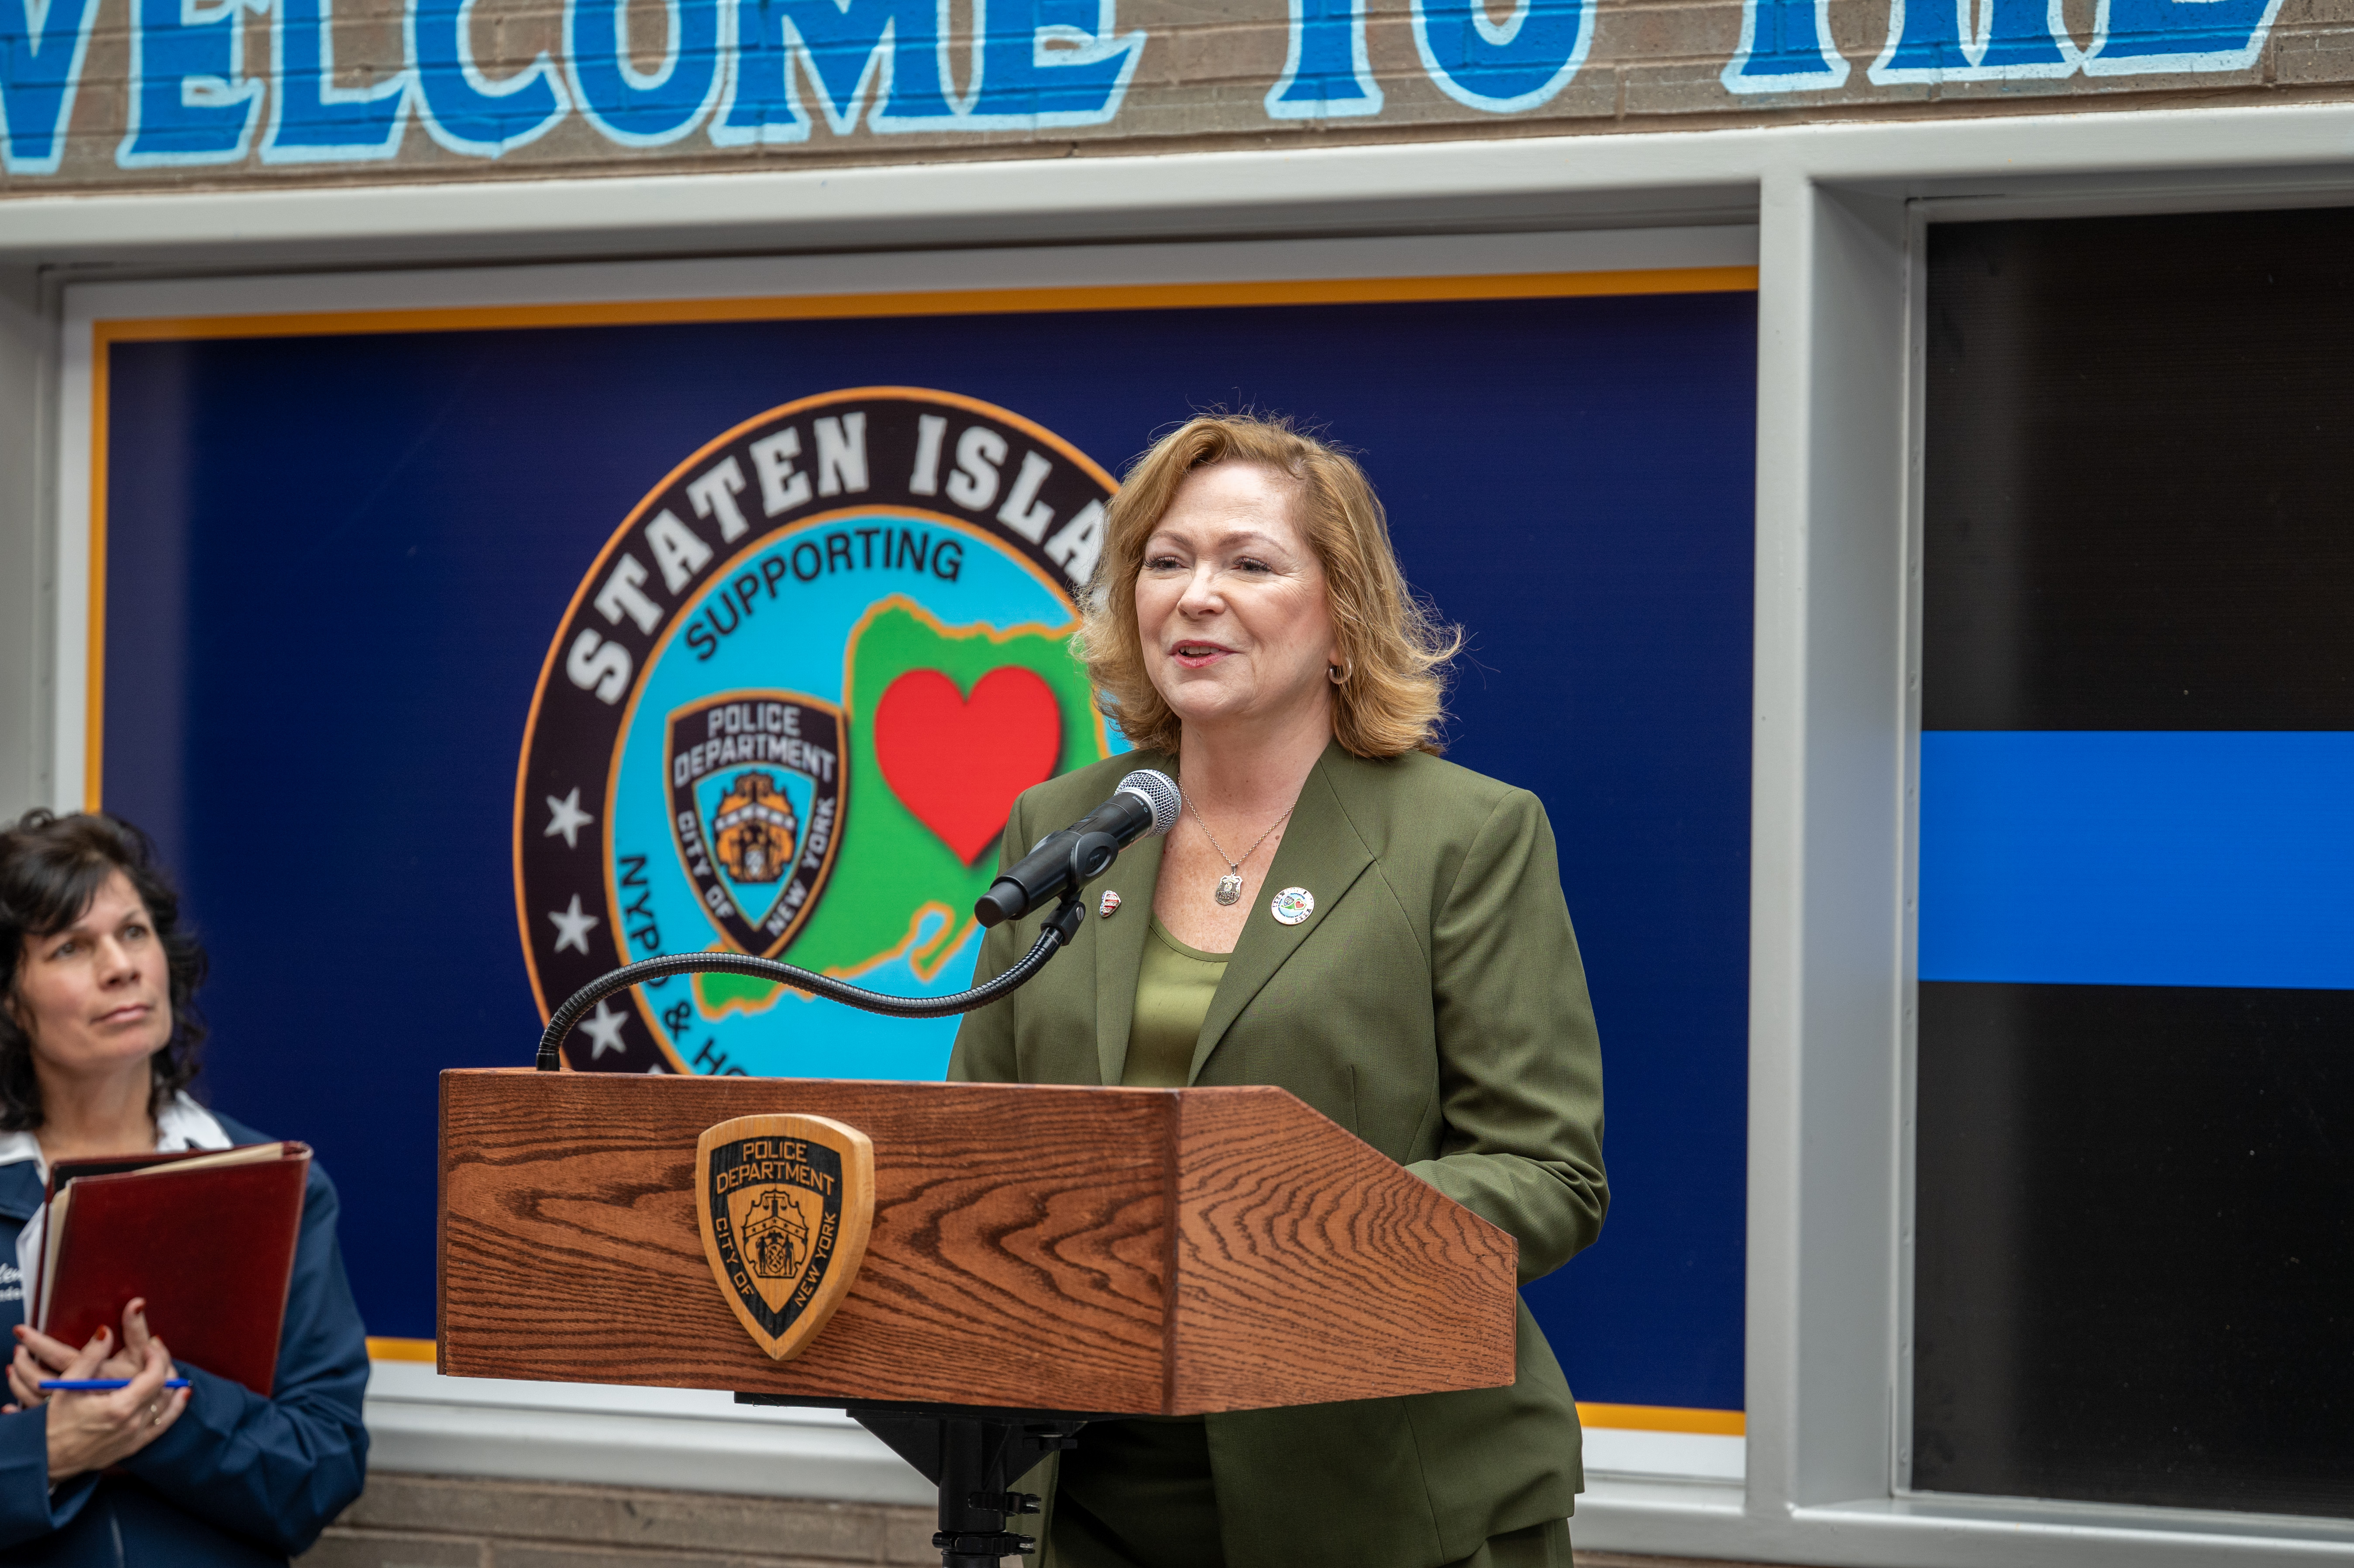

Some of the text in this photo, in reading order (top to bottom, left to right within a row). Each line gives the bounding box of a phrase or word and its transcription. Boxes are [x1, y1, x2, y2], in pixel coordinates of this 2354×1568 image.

[566, 412, 870, 705] STATEN
[685, 529, 963, 662] SUPPORTING
[708, 702, 801, 738] POLICE
[674, 733, 836, 787] DEPARTMENT
[678, 811, 736, 918] CITY OF
[766, 797, 836, 937] NEW YORK
[664, 1002, 691, 1040] &
[716, 1161, 835, 1195] DEPARTMENT
[743, 1141, 807, 1162] POLICE
[716, 1217, 754, 1296] CITY OF
[794, 1211, 836, 1307] NEW YORK
